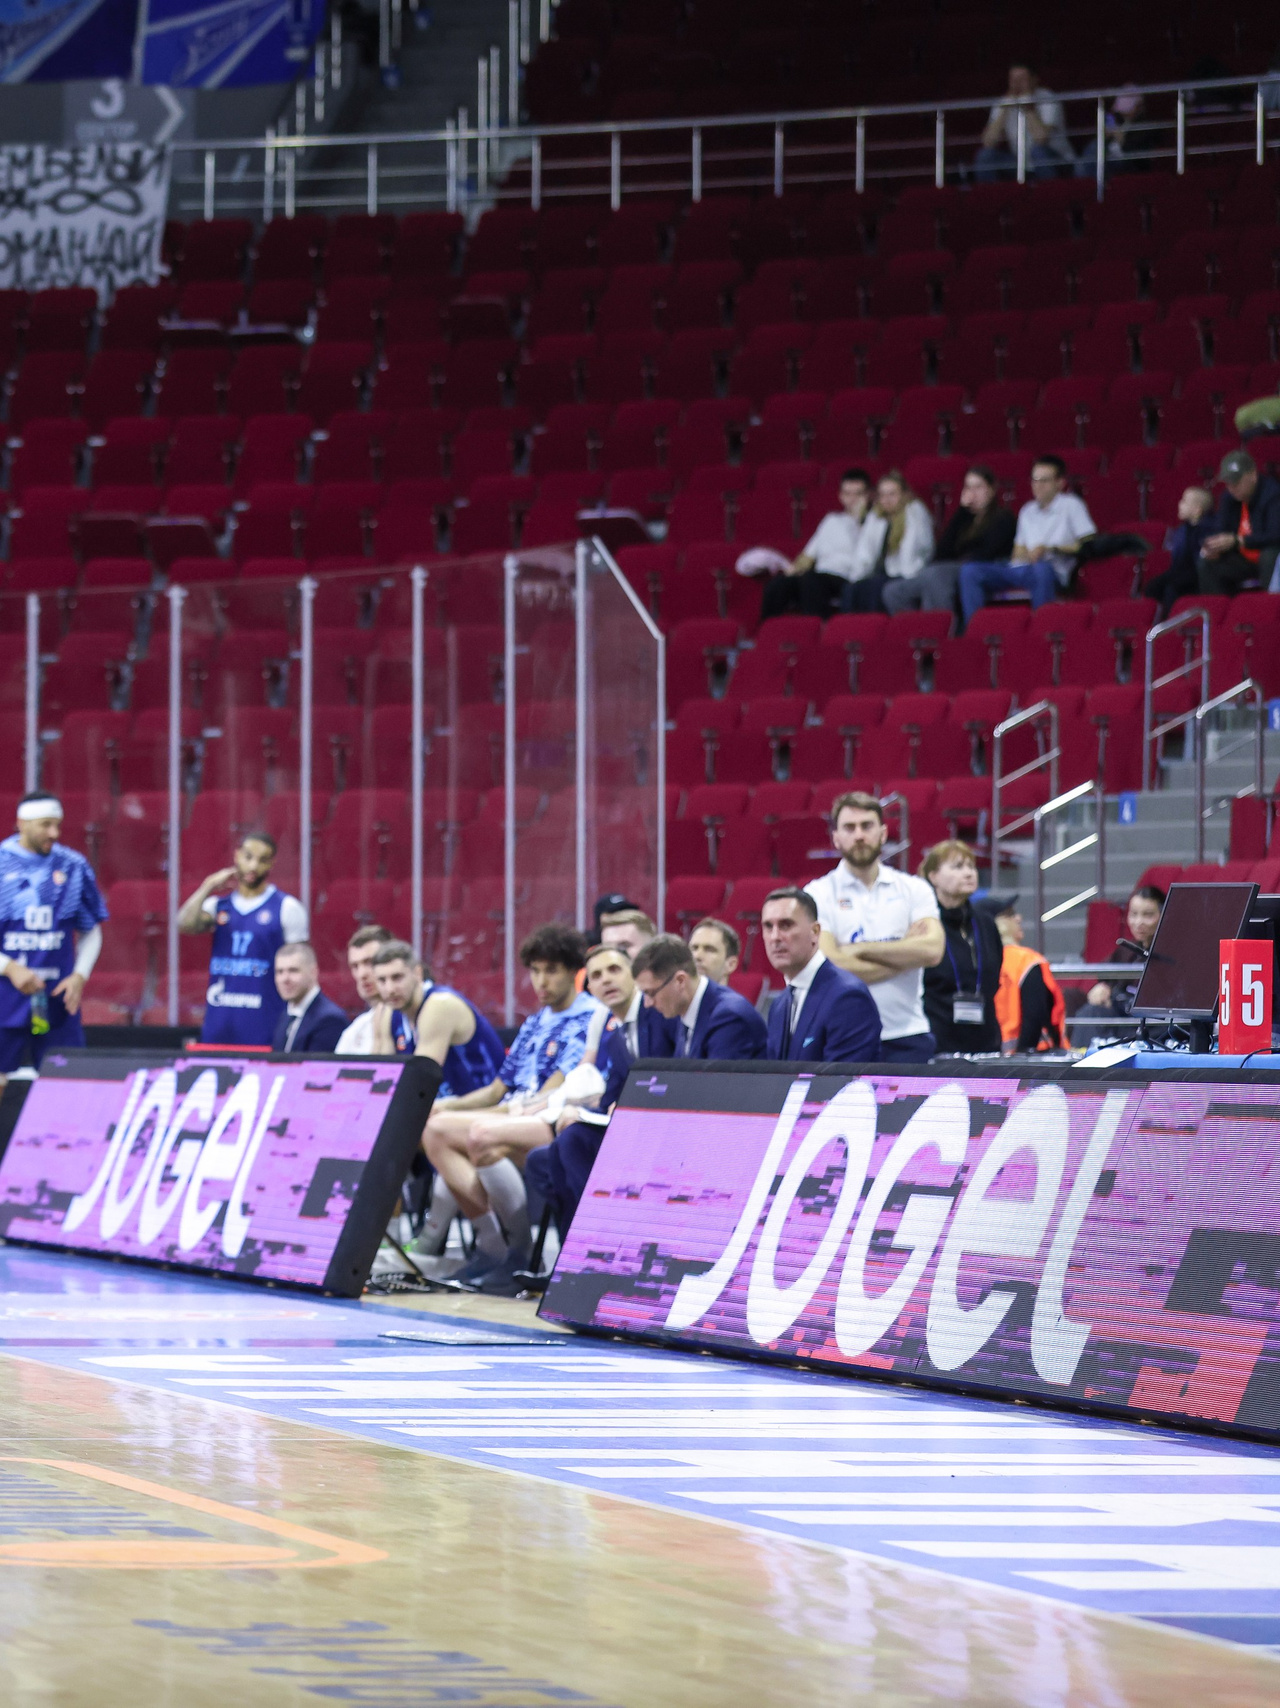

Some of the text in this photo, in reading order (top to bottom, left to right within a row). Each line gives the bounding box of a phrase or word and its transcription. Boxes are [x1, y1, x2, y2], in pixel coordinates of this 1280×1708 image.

[90, 79, 124, 118] 3
[231, 930, 254, 957] 17
[1221, 963, 1230, 1026] 5
[1242, 963, 1264, 1027] 5
[132, 1618, 624, 1708] ЗАРУБ
